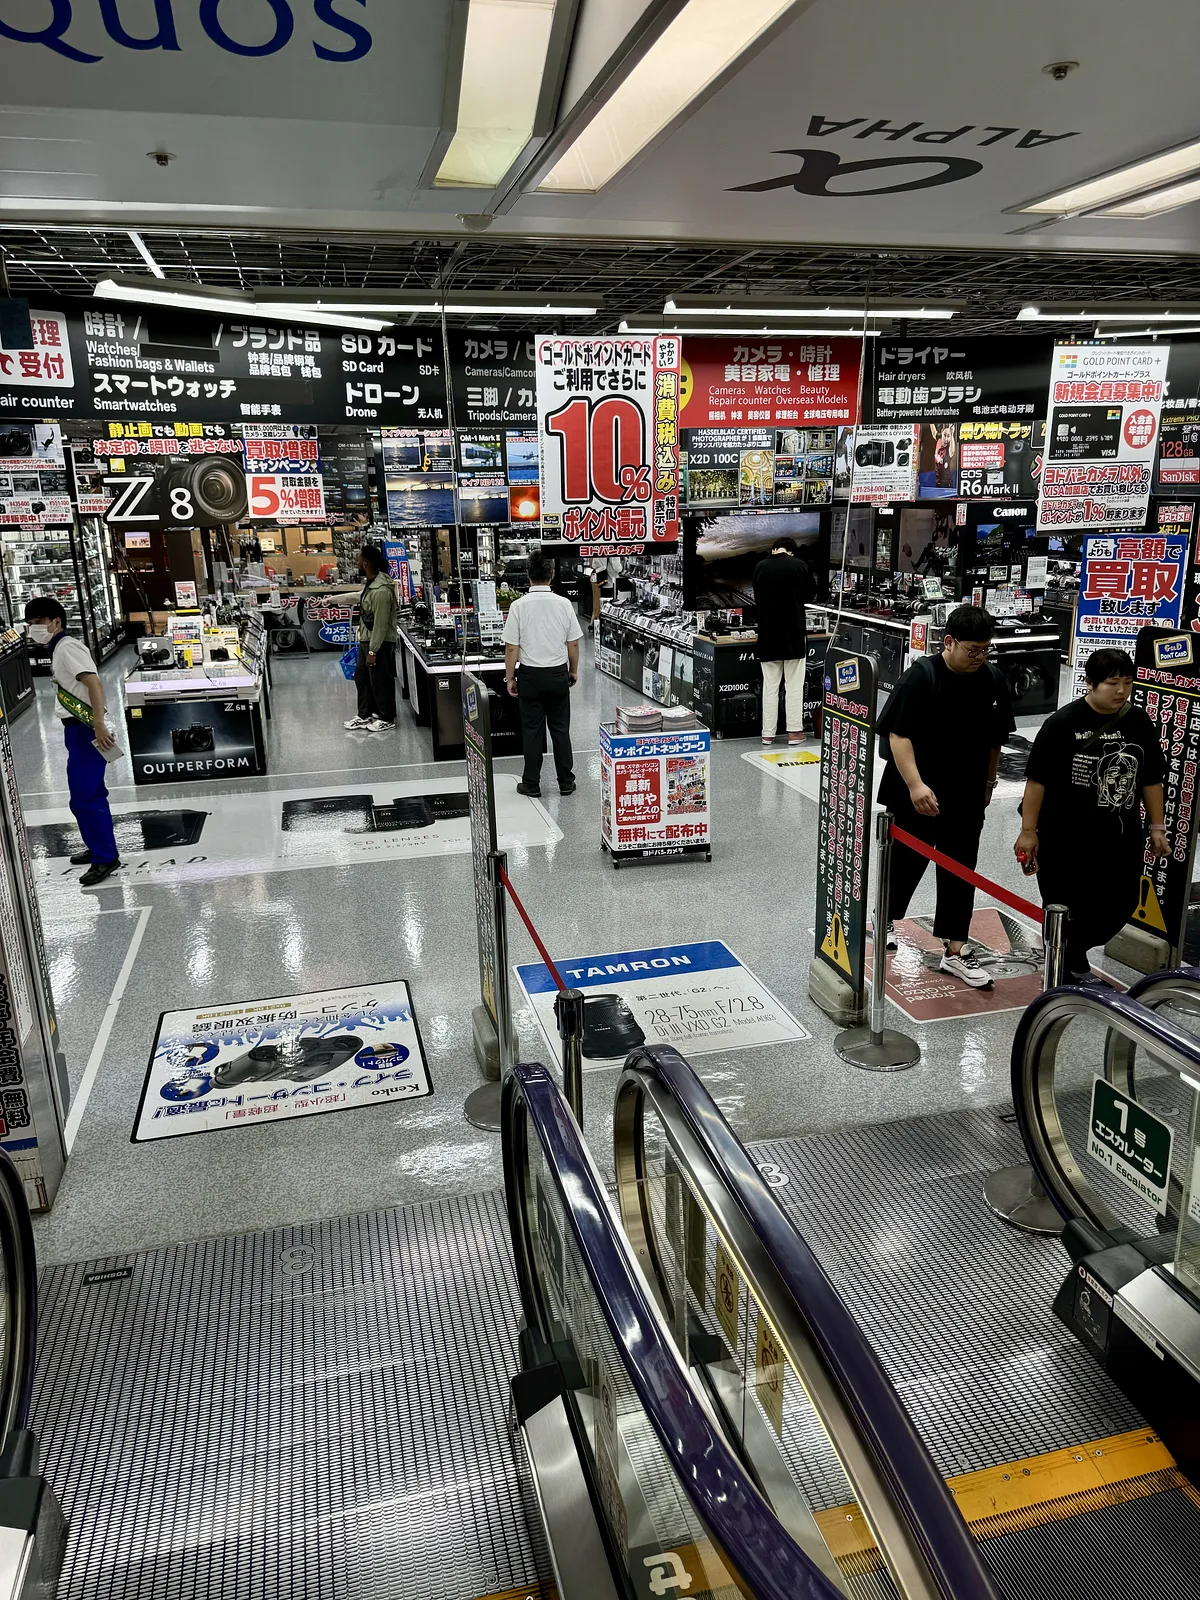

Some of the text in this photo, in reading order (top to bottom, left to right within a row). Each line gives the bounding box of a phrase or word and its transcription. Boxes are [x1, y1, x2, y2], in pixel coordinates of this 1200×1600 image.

[806, 115, 1082, 149] ALPHA
[30, 319, 62, 347] 理
[83, 311, 322, 352] 時計 ブランド品
[341, 333, 434, 359] SD カード
[464, 339, 509, 360] カメラ
[667, 341, 675, 365] わかり
[543, 342, 652, 367] ゴールドポイントカード
[659, 344, 667, 367] やすい
[733, 345, 833, 364] カメラ・時計
[880, 346, 966, 365] ドライヤー
[1083, 355, 1153, 366] GOLD POINT CARD
[88, 354, 215, 374] Fashion bags & Wallets
[248, 364, 322, 379] 品牌包包 钱包
[342, 360, 385, 374] SD Card
[419, 363, 441, 376] SD卡
[553, 367, 647, 391] ご利用でさらに
[724, 363, 841, 383] 美容家電・修理
[878, 370, 926, 384] Hair dryers
[946, 370, 974, 381] 吹风机
[1066, 370, 1151, 379] ゴールドポイントカード・プラス
[93, 373, 238, 398] スマートウォッチ
[346, 381, 420, 406] ドローン
[709, 385, 830, 396] Cameras Watches Beauty
[1054, 380, 1162, 403] 新規会員募集中!
[21, 395, 75, 409] counter
[466, 386, 500, 409] 三脚
[709, 394, 848, 407] Repair counter Overseas Models
[878, 385, 982, 405] 電動歯ブラシ
[93, 397, 178, 414] Smartwatches
[240, 402, 282, 416] 智能手表
[346, 405, 377, 418] Drone
[417, 407, 443, 420] 无人机
[876, 406, 960, 419] Battery-powered toothbrushes
[972, 403, 1035, 415] 电池式电动牙刷
[467, 410, 537, 424] Tripods/Camera
[1129, 415, 1153, 425] 入会金
[108, 422, 226, 438] 静止画でも動画でも
[478, 434, 494, 442] Mark
[655, 372, 678, 494] 消費税込み
[1128, 425, 1152, 435] 年会費
[93, 438, 244, 457] 決定的な瞬間を逃さない
[1132, 435, 1148, 446] 無料
[245, 440, 318, 460] 買取増額
[546, 395, 652, 504] 10%
[1101, 449, 1116, 457] VISA
[247, 460, 312, 473] キャンペーン
[690, 454, 739, 465] X2D 100C
[961, 470, 983, 478] EOS
[1162, 472, 1197, 482] SanDisk
[281, 477, 319, 488] 買取金額を
[960, 480, 1011, 496] R6 Mark
[1043, 483, 1149, 498] VISA加盟店でお買い物しても
[103, 476, 195, 522] Z 8
[665, 495, 676, 522] 特価
[992, 507, 1027, 518] Canon
[563, 506, 646, 542] ポイント還元
[654, 499, 666, 537] 表示で
[579, 544, 645, 557] ヨドバシカメラ
[1088, 548, 1112, 557] よりも
[1092, 540, 1109, 549] どこ
[1117, 538, 1182, 560] 高額で
[1083, 560, 1180, 603] 買取
[1100, 600, 1161, 615] 致します
[1160, 650, 1188, 660] POINT CARD
[1164, 643, 1182, 652] GOLD
[719, 683, 749, 692] X2D100C
[826, 692, 869, 719] ヨドバシカメラ
[614, 741, 706, 757] ザ・ポイントネットワーク
[143, 755, 250, 776] OUTPERFORM
[625, 779, 651, 793] 最新
[619, 793, 658, 807] 情報や
[617, 806, 660, 816] サービスの
[617, 822, 708, 843] 無料にて配布中
[642, 848, 684, 857] ヨドバシカメラ
[566, 954, 692, 980] TAMRON
[191, 998, 379, 1033] ケンコー防振双眼鏡
[644, 995, 765, 1025] 28-75mm F/2.8
[653, 1016, 757, 1037] Di III VXD G2 Model
[371, 1082, 421, 1098] Kenko
[5, 1088, 30, 1129] 無料
[1095, 1118, 1163, 1179] エスカレーター
[1091, 1139, 1115, 1168] No.1
[1115, 1161, 1164, 1206] Escalator
[88, 1270, 128, 1282] TOSHIBA
